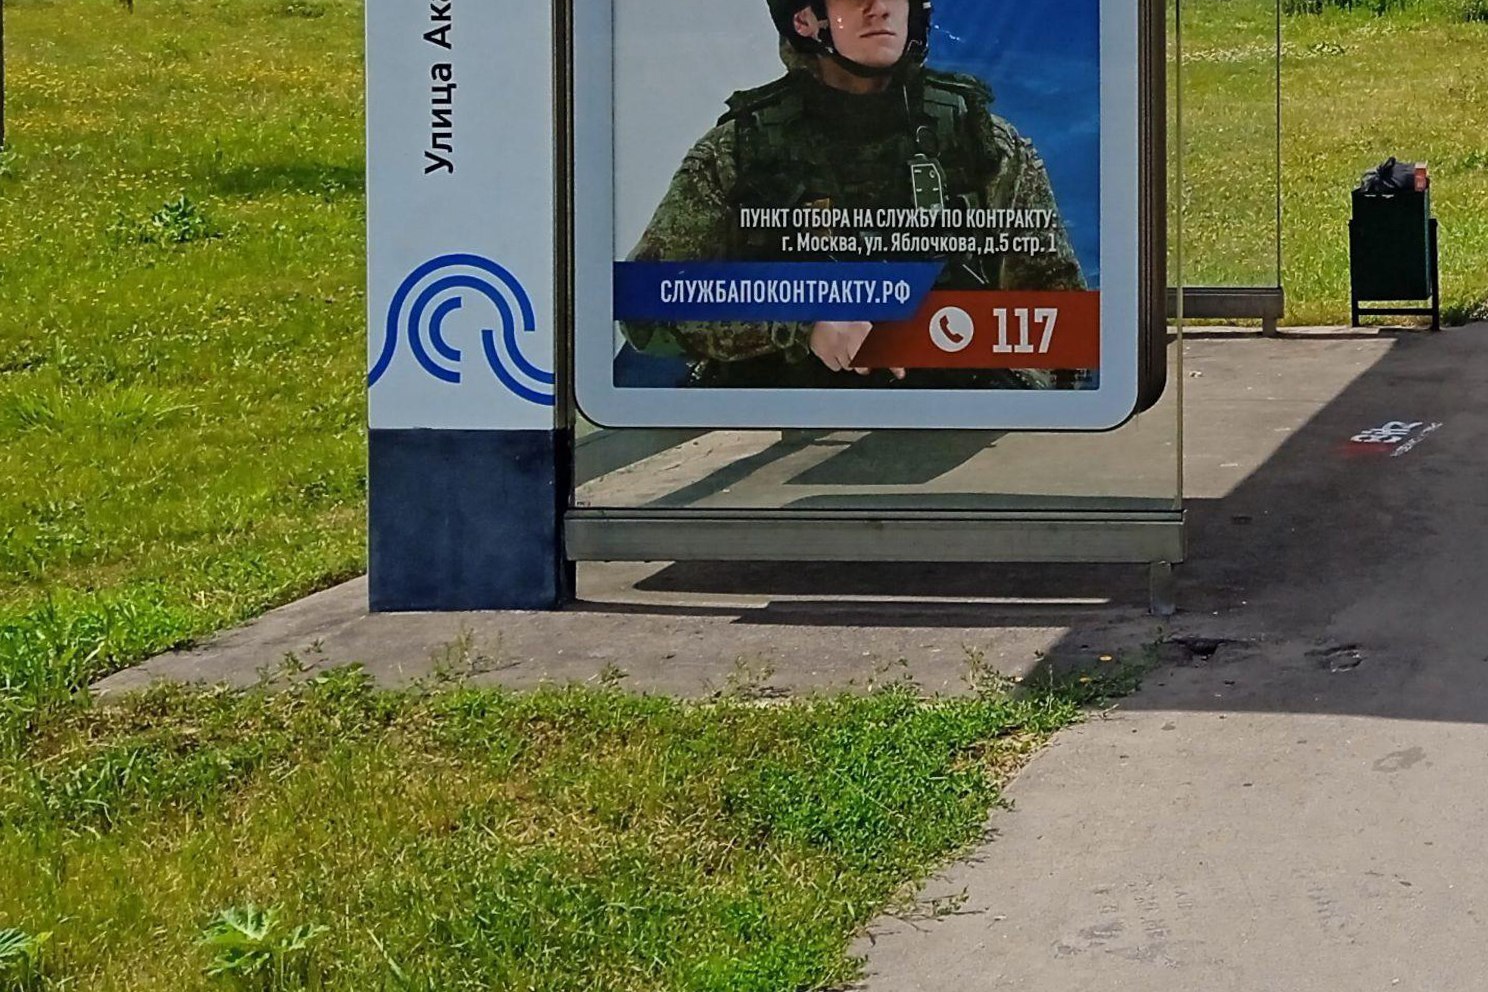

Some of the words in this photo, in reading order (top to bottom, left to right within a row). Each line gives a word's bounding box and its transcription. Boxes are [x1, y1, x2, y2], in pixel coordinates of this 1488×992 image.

[423, 62, 457, 176] Улица
[740, 208, 790, 229] ПУНКТ
[792, 208, 851, 229] ОТБОРА
[855, 208, 873, 229] НА
[876, 208, 938, 229] СЛУЖБУ
[941, 208, 963, 229] ПО
[966, 208, 1057, 229] КОНТРАКТУ:
[781, 237, 793, 252] г.
[796, 234, 862, 254] Москва,
[864, 237, 888, 256] ул.
[891, 233, 982, 254] Яблочкова,
[984, 233, 1009, 255] д.5
[1012, 236, 1046, 256] стр.
[1048, 233, 1056, 252] 1
[660, 278, 911, 305] СЛУЖБАПОКОНТРАКТУ.РФ
[992, 307, 1058, 354] 117
